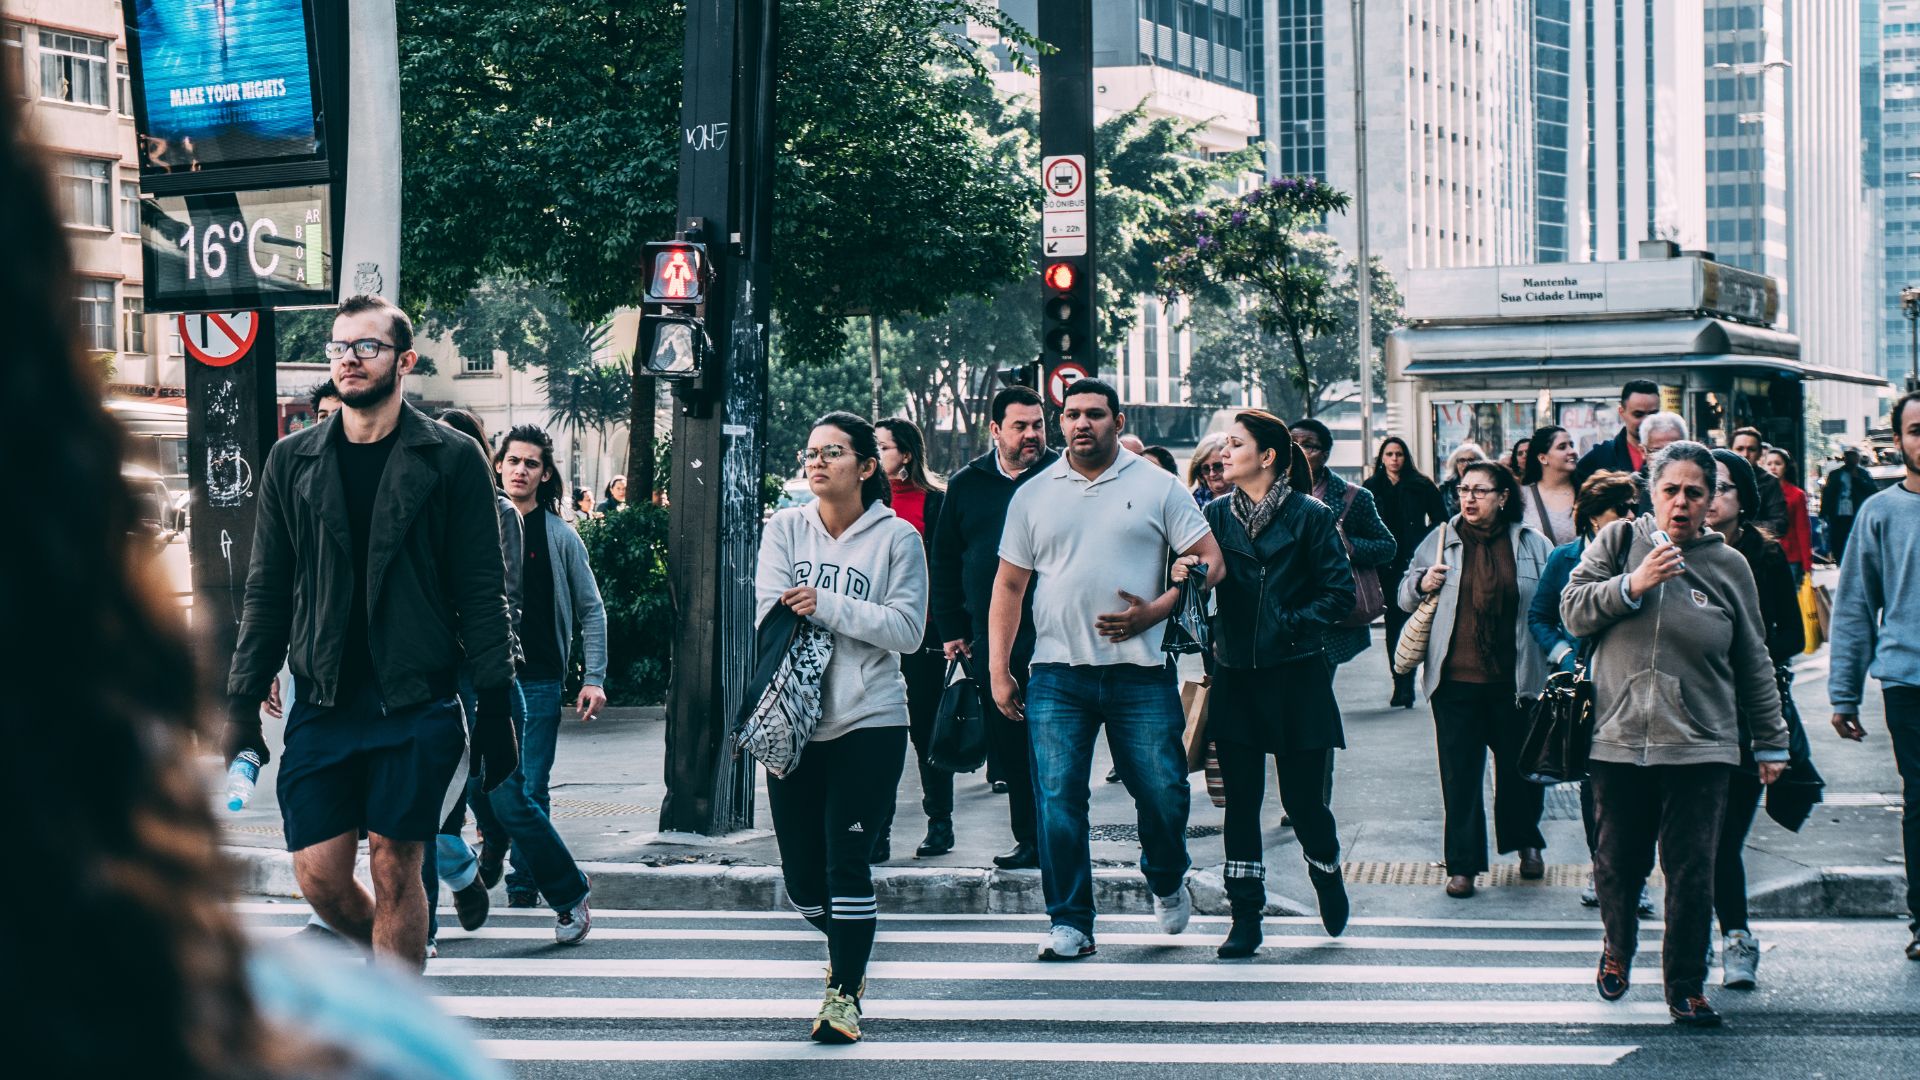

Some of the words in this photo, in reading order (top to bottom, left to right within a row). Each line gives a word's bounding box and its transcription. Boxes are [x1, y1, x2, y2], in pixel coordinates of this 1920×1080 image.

[170, 87, 205, 107] MAKE
[205, 82, 241, 103] YOUR
[241, 79, 286, 100] NIGHTS
[305, 208, 320, 223] AR
[1066, 225, 1080, 233] 22h
[1523, 277, 1578, 287] Mantenha
[1501, 292, 1522, 302] Sua
[1525, 291, 1565, 302] Cidade
[1568, 290, 1604, 301] Limpa
